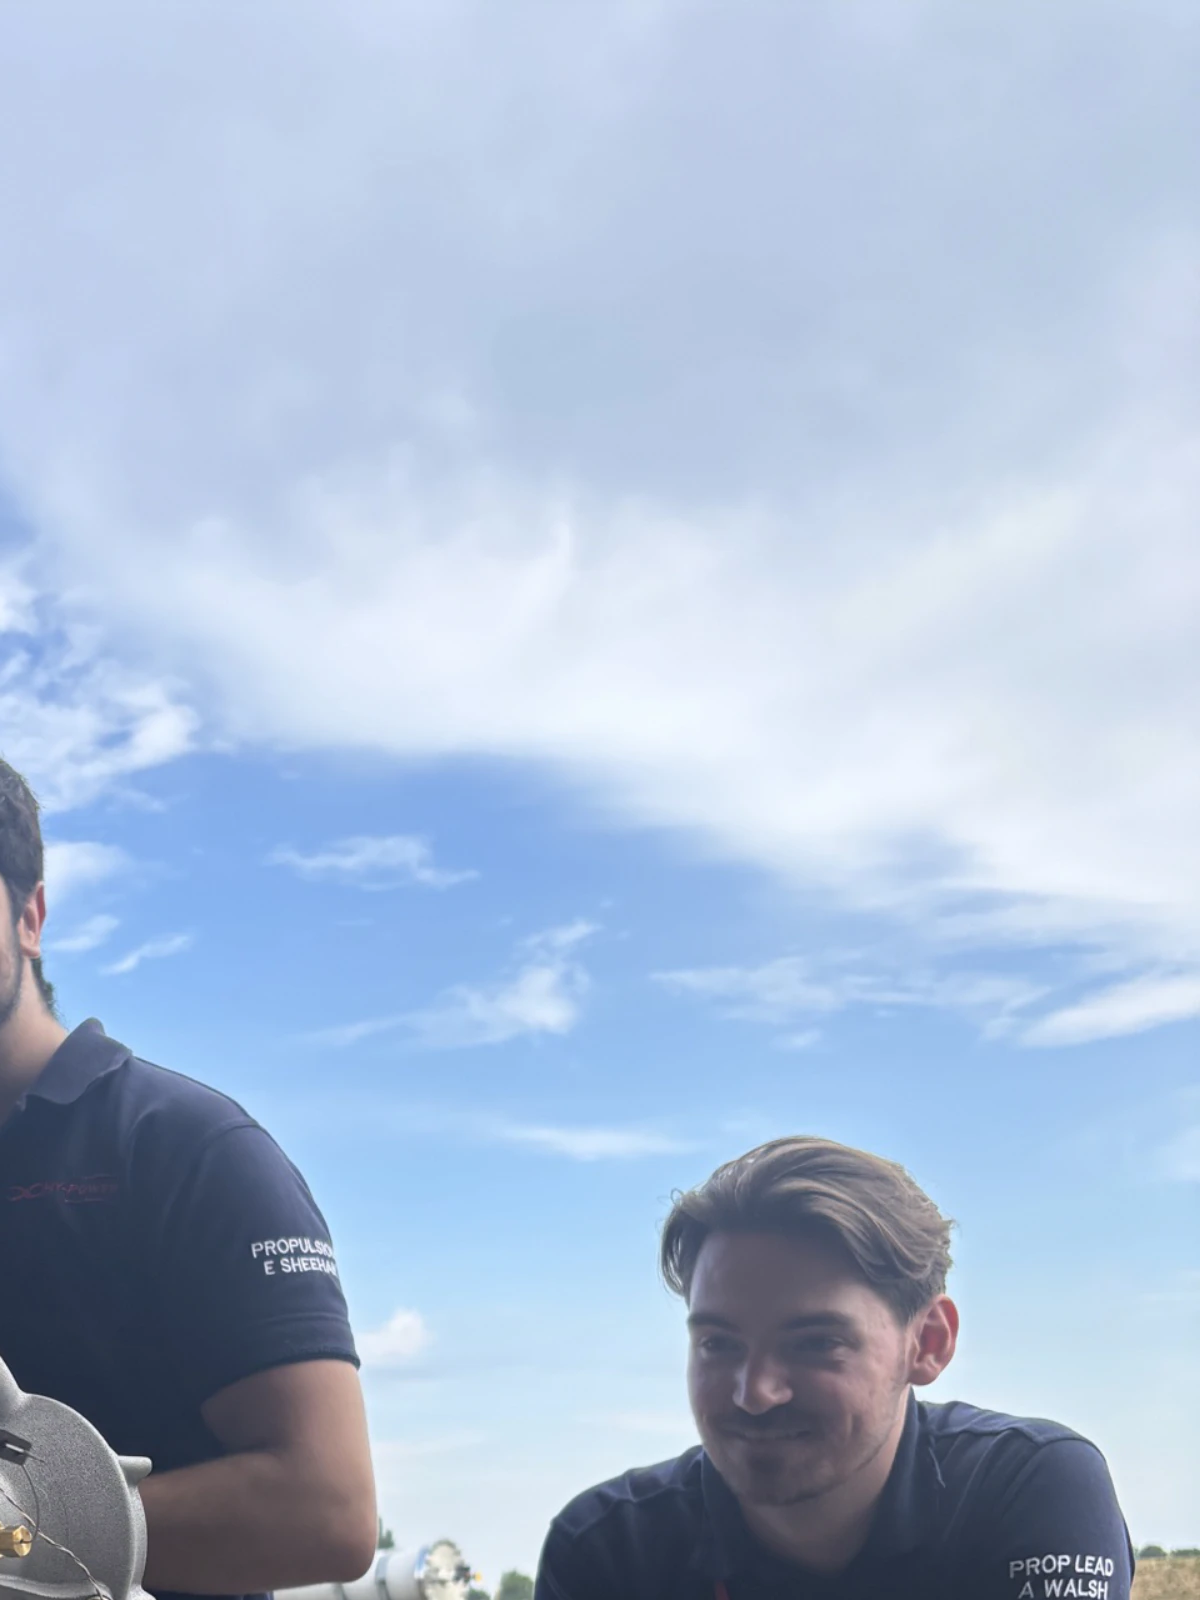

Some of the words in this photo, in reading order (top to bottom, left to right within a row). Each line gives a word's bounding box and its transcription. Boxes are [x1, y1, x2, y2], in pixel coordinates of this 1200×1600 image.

[251, 1237, 333, 1258] PROPULSIO
[1009, 1554, 1071, 1579] PROP
[1075, 1554, 1114, 1577] LEAD
[1018, 1581, 1034, 1599] A
[1044, 1578, 1108, 1600] WALSH
